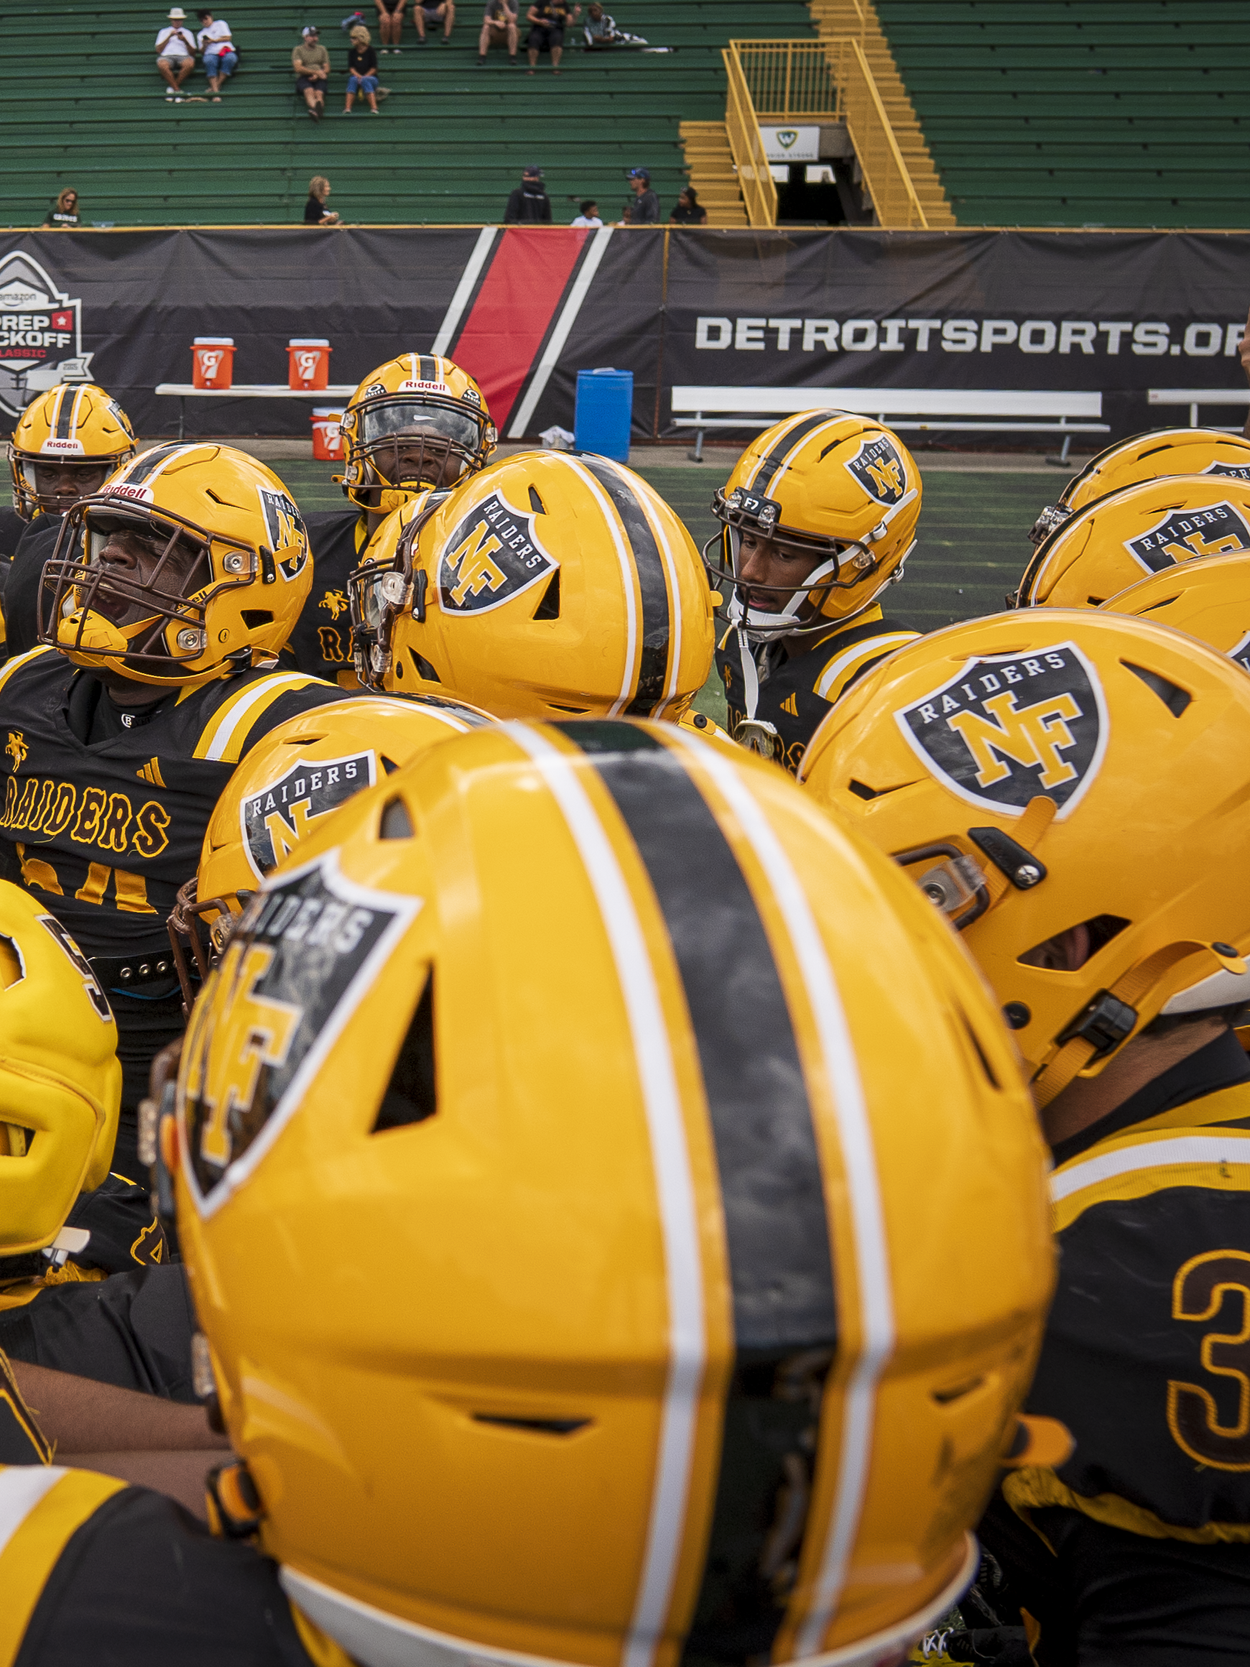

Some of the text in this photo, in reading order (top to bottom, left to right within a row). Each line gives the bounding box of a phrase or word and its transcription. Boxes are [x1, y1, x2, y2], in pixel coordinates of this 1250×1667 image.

[203, 352, 217, 366] G
[301, 353, 314, 367] G
[405, 381, 446, 391] Riddell
[47, 441, 78, 449] Riddell
[853, 439, 889, 471] RAIDERS
[865, 457, 903, 497] NF
[743, 496, 759, 510] F7
[483, 500, 542, 568] RAIDERS
[1140, 508, 1229, 551] RAIDERS
[445, 519, 508, 607] NF
[918, 653, 1066, 724] RAIDERS
[946, 690, 1084, 790] NF
[252, 762, 357, 818] RAIDERS
[1165, 1248, 1250, 1472] 3
